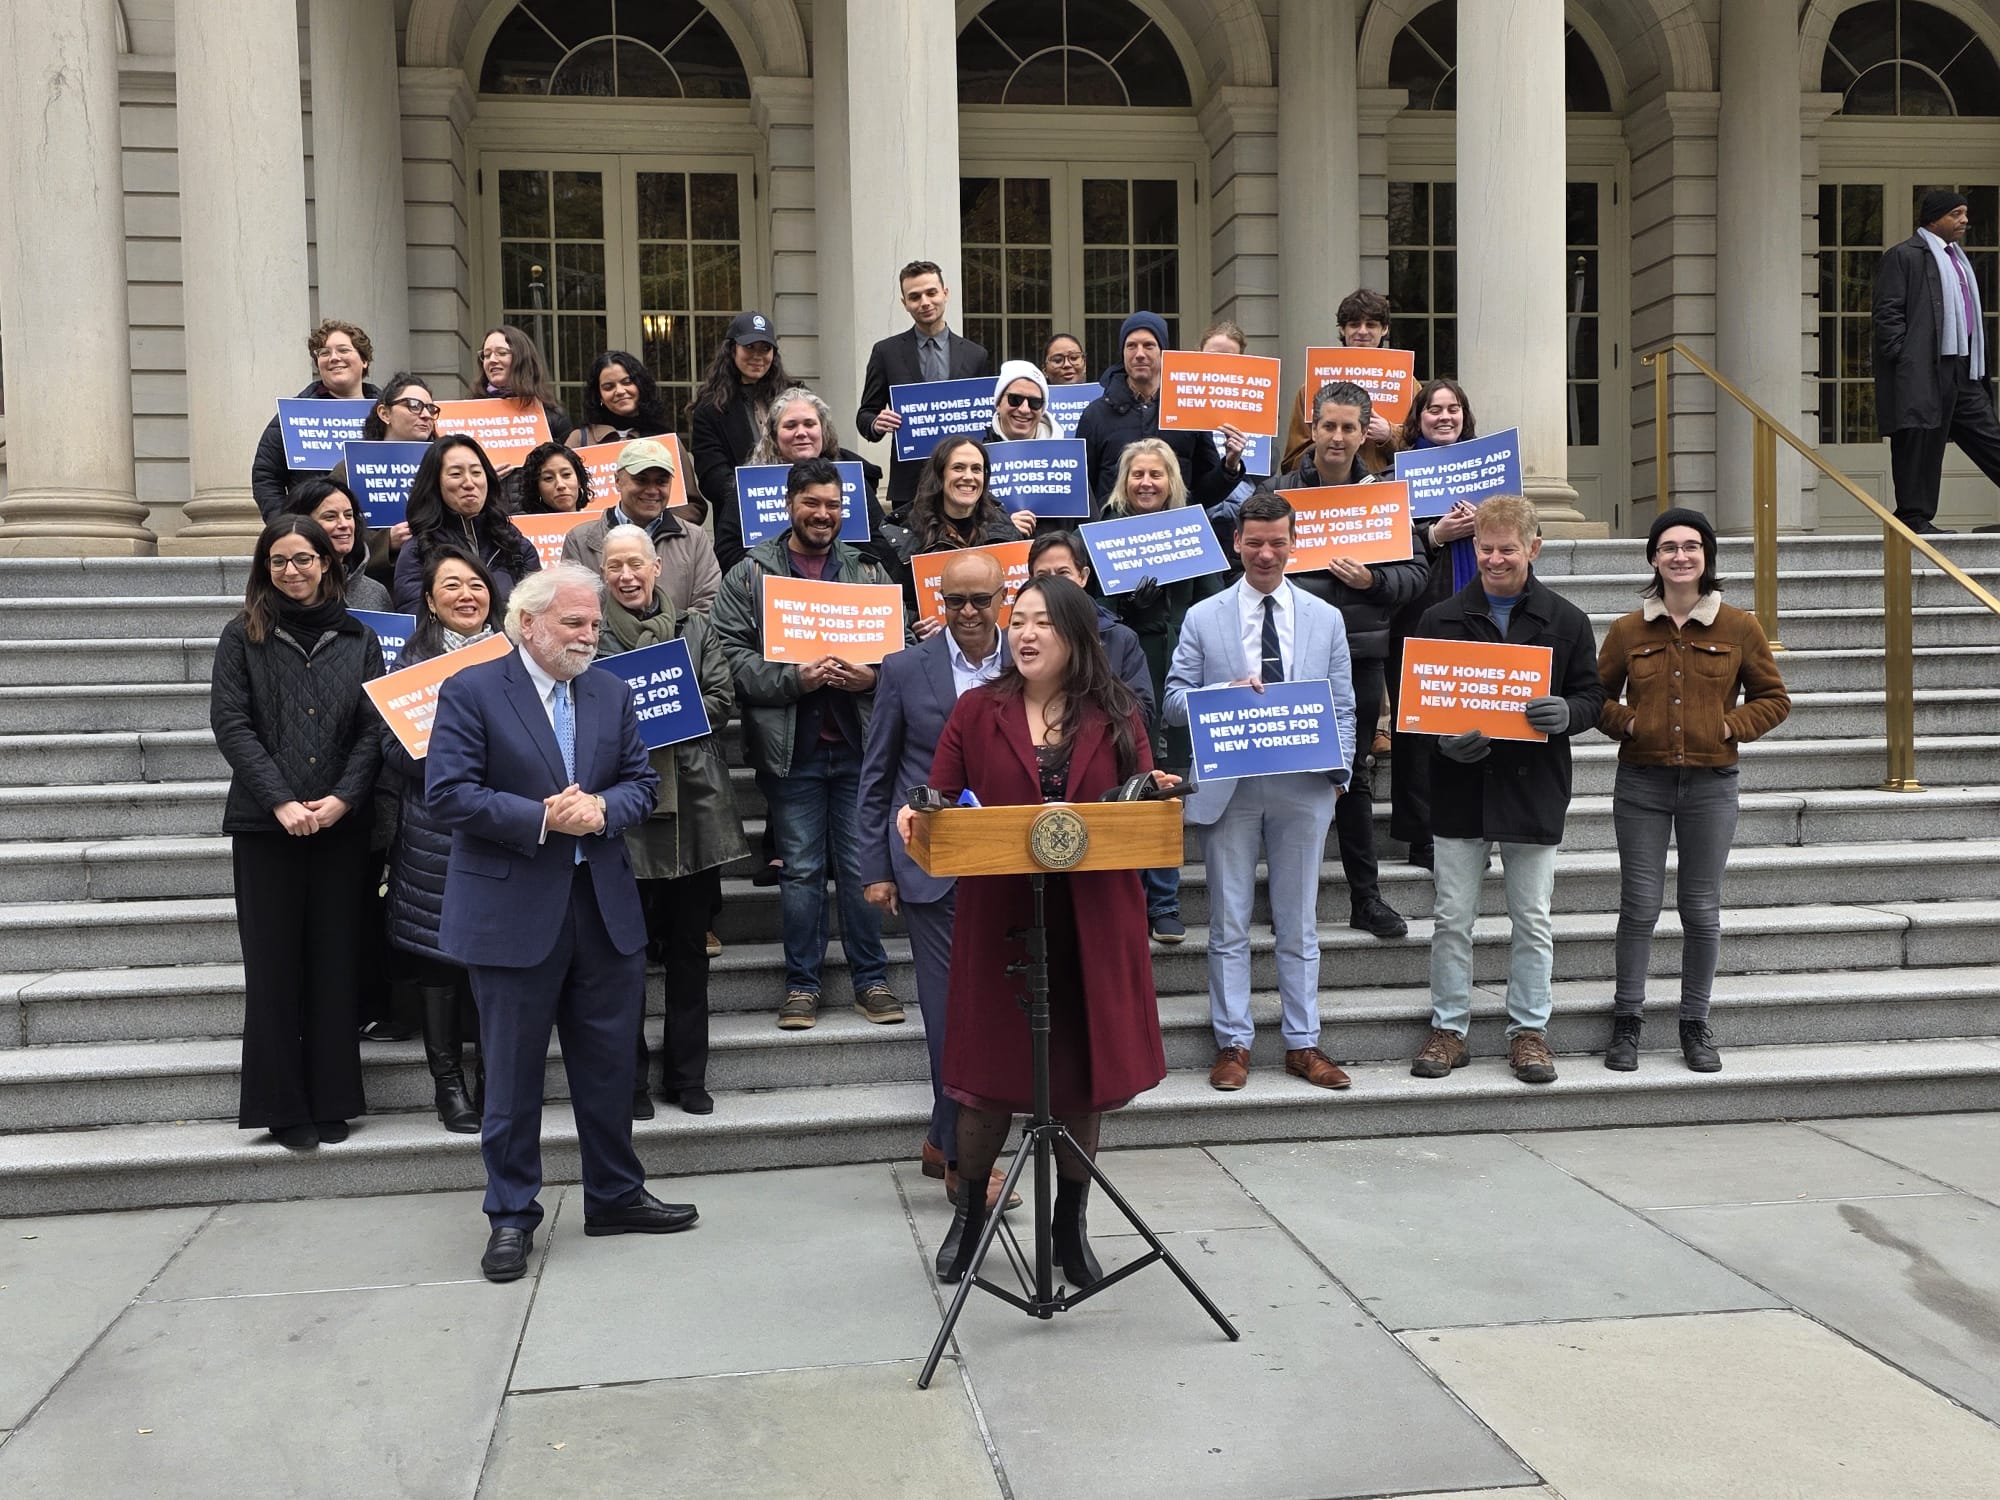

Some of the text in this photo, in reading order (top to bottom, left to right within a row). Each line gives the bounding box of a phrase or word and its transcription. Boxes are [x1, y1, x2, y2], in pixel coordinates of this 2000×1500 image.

[1170, 372, 1271, 387] NEW HOMES AND
[1315, 367, 1406, 378] NEW HOMES AND
[1176, 385, 1264, 399] NEW JOBS FOR
[1381, 382, 1400, 390] FOR
[901, 403, 928, 413] NEW
[931, 399, 970, 410] HOMES
[1177, 398, 1263, 412] NEW YORKERS
[289, 417, 319, 426] NEW
[438, 415, 537, 427] NEW HOMES AND
[909, 410, 992, 425] NEW JOBS FOR
[299, 430, 363, 438] NEW JOBS
[478, 428, 508, 437] JOBS
[511, 427, 534, 435] FOR
[912, 427, 938, 437] NEW
[302, 441, 331, 450] NEW
[481, 439, 536, 448] YORKERS
[356, 464, 387, 474] NEW
[1005, 460, 1048, 470] HOMES
[1051, 459, 1078, 468] AND
[1405, 450, 1511, 477] NEW HOMES AND
[1012, 472, 1044, 482] JOBS
[1047, 472, 1072, 481] FOR
[1413, 464, 1505, 487] NEW JOBS FOR
[365, 479, 396, 488] NEW
[1015, 485, 1071, 494] YORKERS
[1414, 476, 1505, 498] NEW YORKERS
[369, 492, 400, 502] NEW
[747, 487, 777, 497] NEW
[756, 500, 785, 510] NEW
[1295, 504, 1400, 520] EW HOMES AND
[760, 512, 789, 523] NEW
[1295, 518, 1393, 534] NEW JOBS FOR
[1095, 524, 1202, 550] NEW HOMES AND
[1296, 531, 1392, 548] NEW YORKERS
[1106, 536, 1200, 560] NEW JOBS FOR
[1113, 547, 1204, 571] NEW YORKERS
[774, 599, 893, 616] NEW HOMES AND
[782, 614, 885, 629] NEW JOBS FOR
[784, 628, 884, 643] NEW YORKERS
[651, 667, 683, 684] AND
[1413, 664, 1541, 682] NEW HOMES AND
[648, 685, 679, 701] FOR
[1421, 680, 1532, 697] NEW JOBS FOR
[387, 690, 422, 710] NEW
[1421, 695, 1456, 707] NEW
[1199, 703, 1324, 724] NEW HOMES AND
[1210, 719, 1319, 738] NEW JOBS FOR
[1214, 734, 1319, 752] NEW YORKERS
